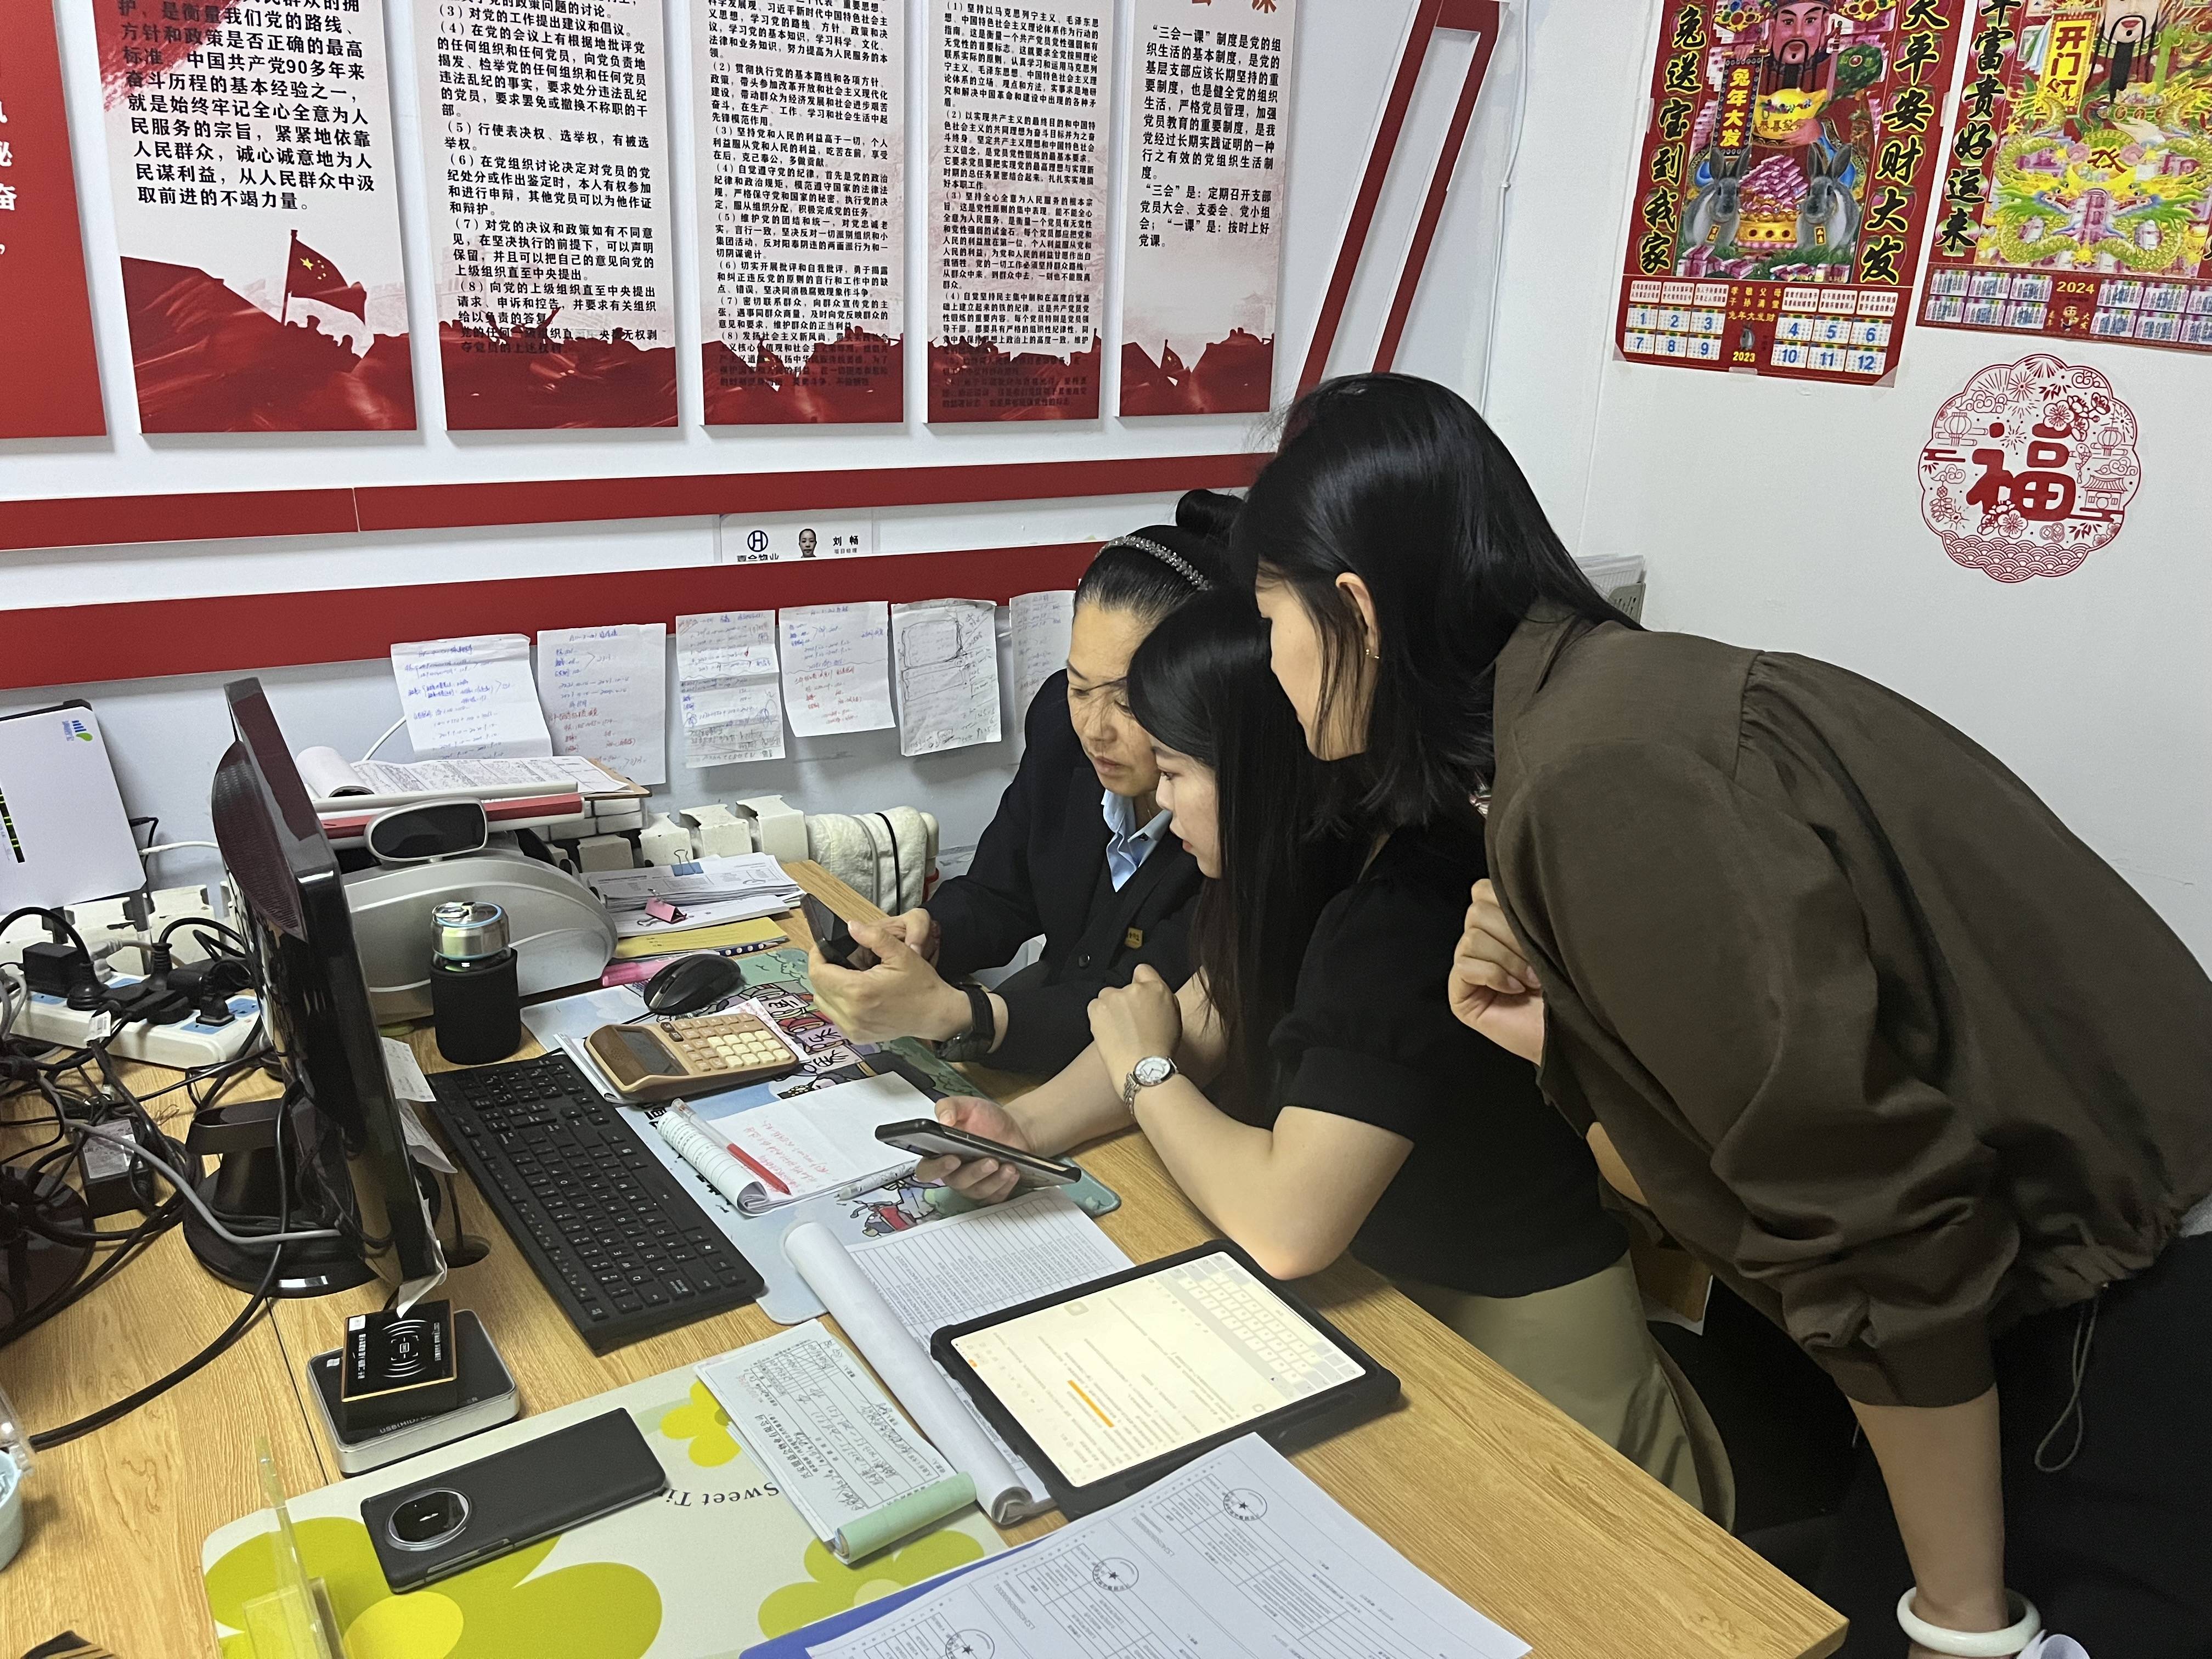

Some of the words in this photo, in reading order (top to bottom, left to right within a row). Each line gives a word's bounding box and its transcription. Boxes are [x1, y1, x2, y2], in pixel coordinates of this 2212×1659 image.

[122, 24, 363, 57] 方针和政策是否正确的最高
[123, 47, 364, 80] 标准。中国共产党90多年来
[1147, 42, 1280, 70] 织生活的基本制度，是党的
[1146, 60, 1279, 87] 基层支部应该长期坚持的重
[126, 71, 357, 103] 奋斗历程的基本经验之一，
[1144, 78, 1278, 103] 要制度，也是健全党的组织
[128, 94, 368, 125] 就是始终牢记全心全意为人
[442, 104, 461, 118] 部。
[1144, 96, 1277, 121] 生活，严格党员管理，加强
[1719, 67, 1751, 148] 兔年大发
[131, 117, 370, 148] 民服务的宗旨，紧紧地依靠
[1143, 114, 1276, 137] 党员教育的重要制度，是我
[444, 137, 477, 152] 举权。
[1143, 131, 1274, 154] 党经过长期实践证明的一种
[134, 142, 373, 169] 人民群众，诚心诚意地为人
[1142, 148, 1273, 170] 行之有效的党组织生活制
[136, 163, 374, 191] 民谋利益，从人民群众中汲
[1141, 166, 1157, 180] 度。
[138, 188, 308, 210] 取前进的不竭力量。
[1140, 200, 1271, 219] 党员大会、支委会、党小组
[1138, 234, 1166, 247] 党课。
[2056, 281, 2095, 295] 2024
[1639, 313, 1646, 325] 1
[1670, 315, 1679, 328] 2
[1704, 318, 1712, 330] 3
[1788, 323, 1799, 336] 4
[1827, 325, 1836, 338] 5
[1865, 328, 1875, 341] 6
[1637, 337, 1643, 349] 7
[1667, 340, 1675, 352] 8
[1701, 342, 1708, 355] 9
[1733, 352, 1756, 363] 2023
[1782, 349, 1797, 363] 10
[1820, 352, 1834, 366] 11
[1858, 356, 1874, 370] 12
[1966, 422, 2076, 522] 福
[702, 1482, 780, 1505] Sweet
